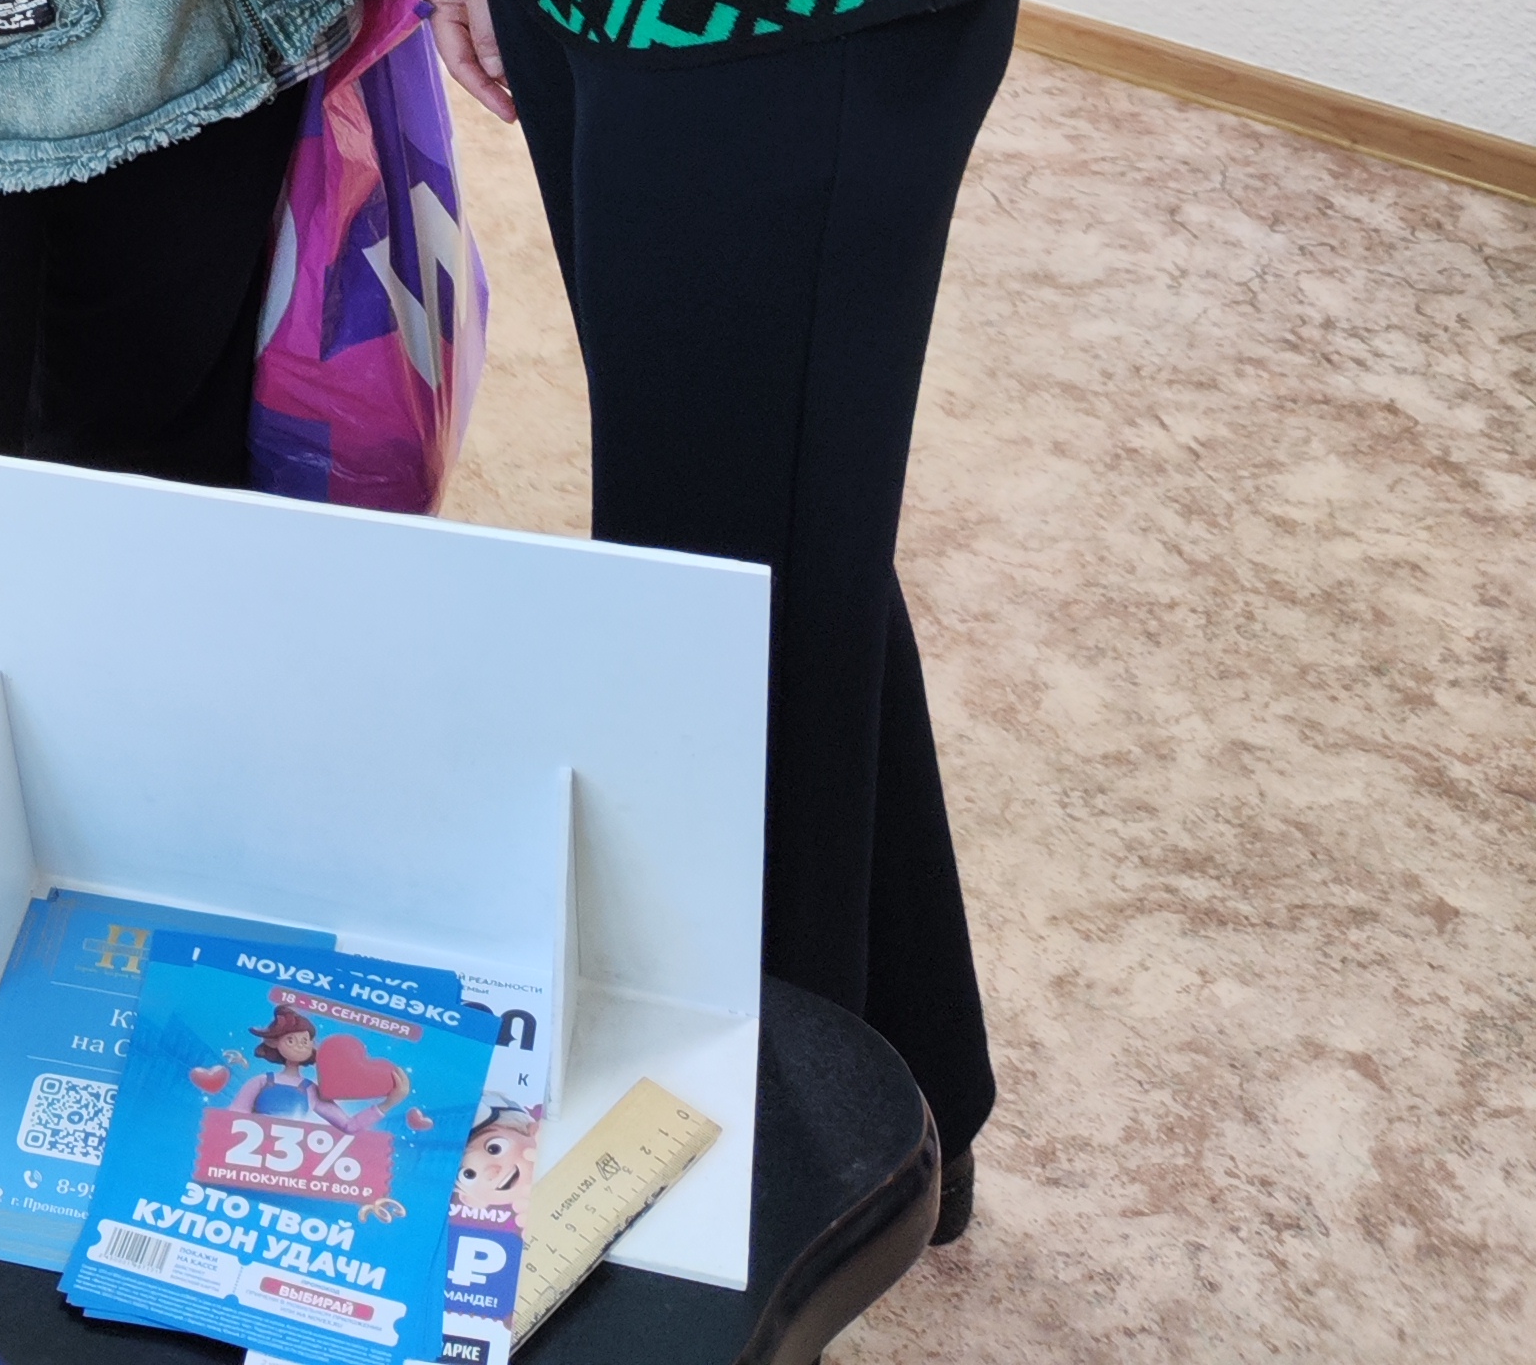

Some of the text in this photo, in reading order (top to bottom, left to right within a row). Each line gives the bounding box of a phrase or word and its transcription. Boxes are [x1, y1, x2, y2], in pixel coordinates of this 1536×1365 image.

[468, 975, 544, 995] РЕАЛЬНОСТИ
[280, 990, 411, 1038] 18 30 СЕНТЯБРЯ
[351, 982, 462, 1028] НОВЭКС
[71, 1034, 106, 1055] на
[676, 1109, 690, 1120] 0
[658, 1127, 670, 1138] 1
[225, 1118, 362, 1183] 23%
[639, 1144, 653, 1157] 2
[207, 1166, 237, 1182] ПРИ
[239, 1169, 308, 1191] ПОКУПКЕ
[310, 1179, 329, 1192] ОТ
[331, 1182, 358, 1196] 800
[180, 1181, 355, 1252] ЭТО ТВОЙ
[584, 1203, 597, 1216] 5
[565, 1222, 578, 1235] 6
[132, 1197, 387, 1291] КУПОН УДАЧИ
[545, 1241, 558, 1255] 7
[179, 1245, 219, 1264] ПОКАЖИ
[525, 1261, 538, 1274] 8
[277, 1285, 355, 1316] ВЫБИРАЙ
